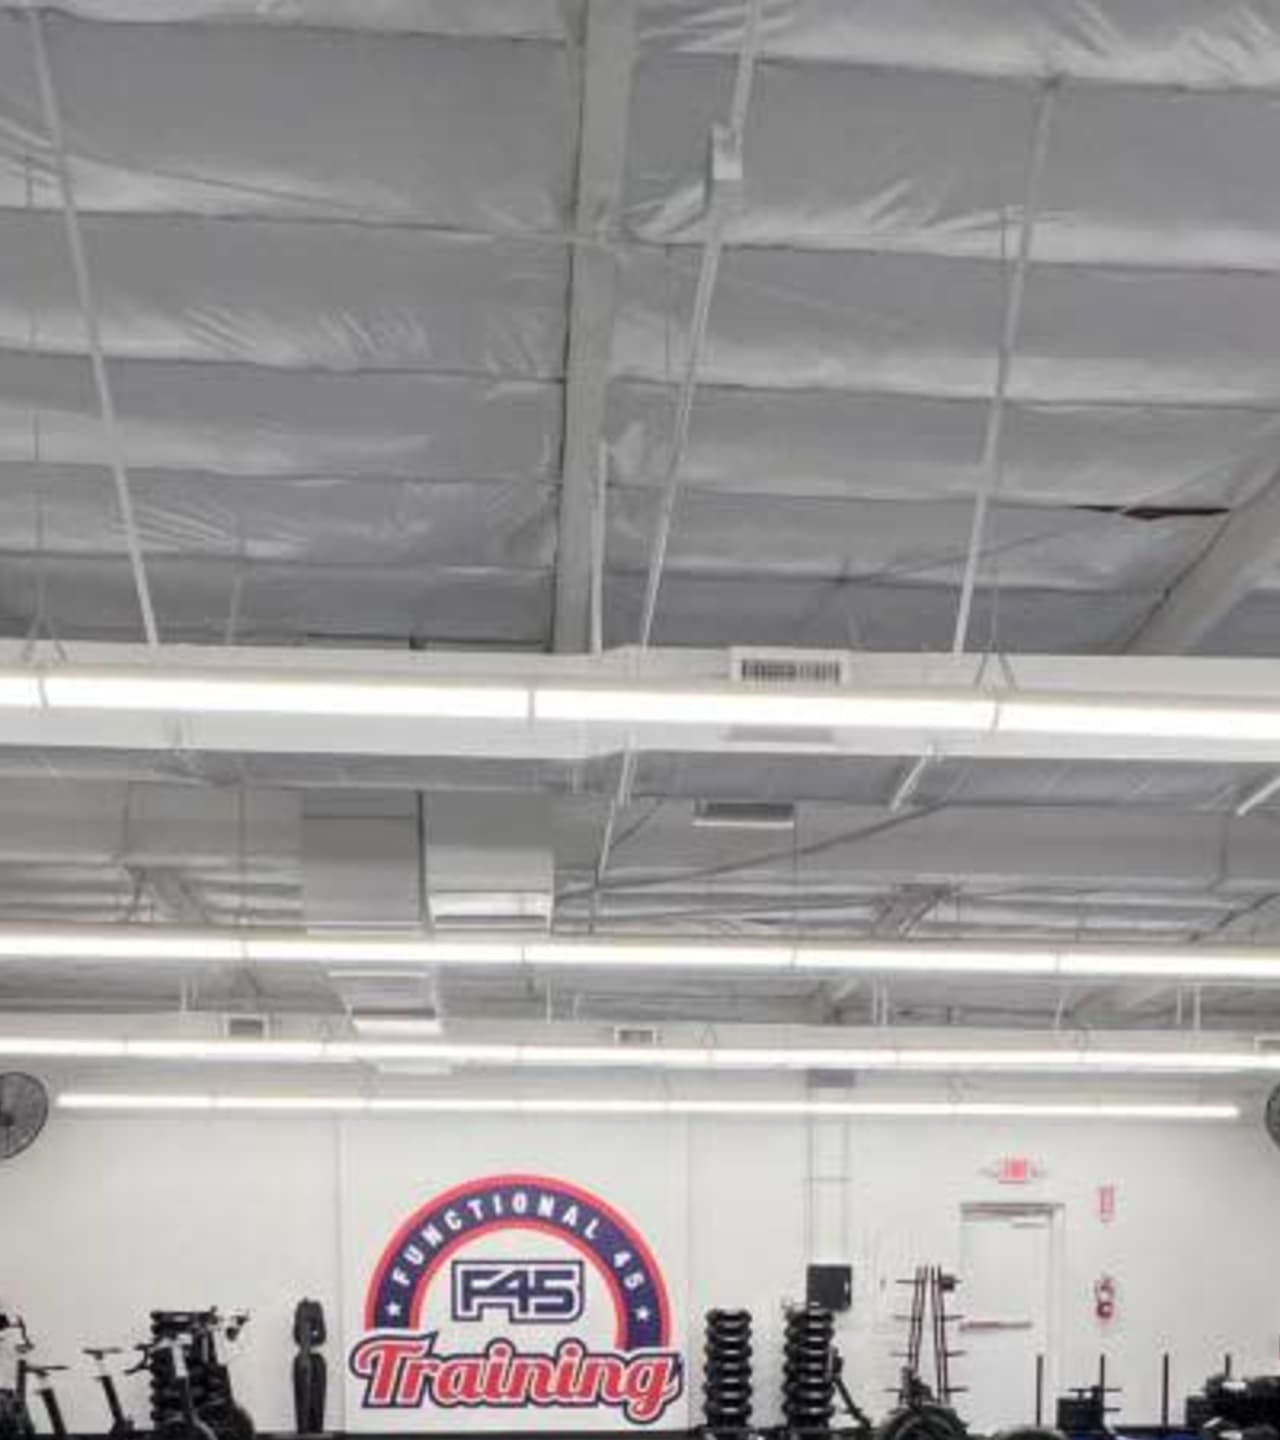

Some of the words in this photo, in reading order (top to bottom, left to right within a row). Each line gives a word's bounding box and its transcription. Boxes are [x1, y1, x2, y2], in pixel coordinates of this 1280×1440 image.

[392, 1192, 599, 1287] FUNCTIONAL
[613, 1251, 646, 1290] 45
[452, 1260, 584, 1322] F45
[351, 1331, 684, 1424] Training
